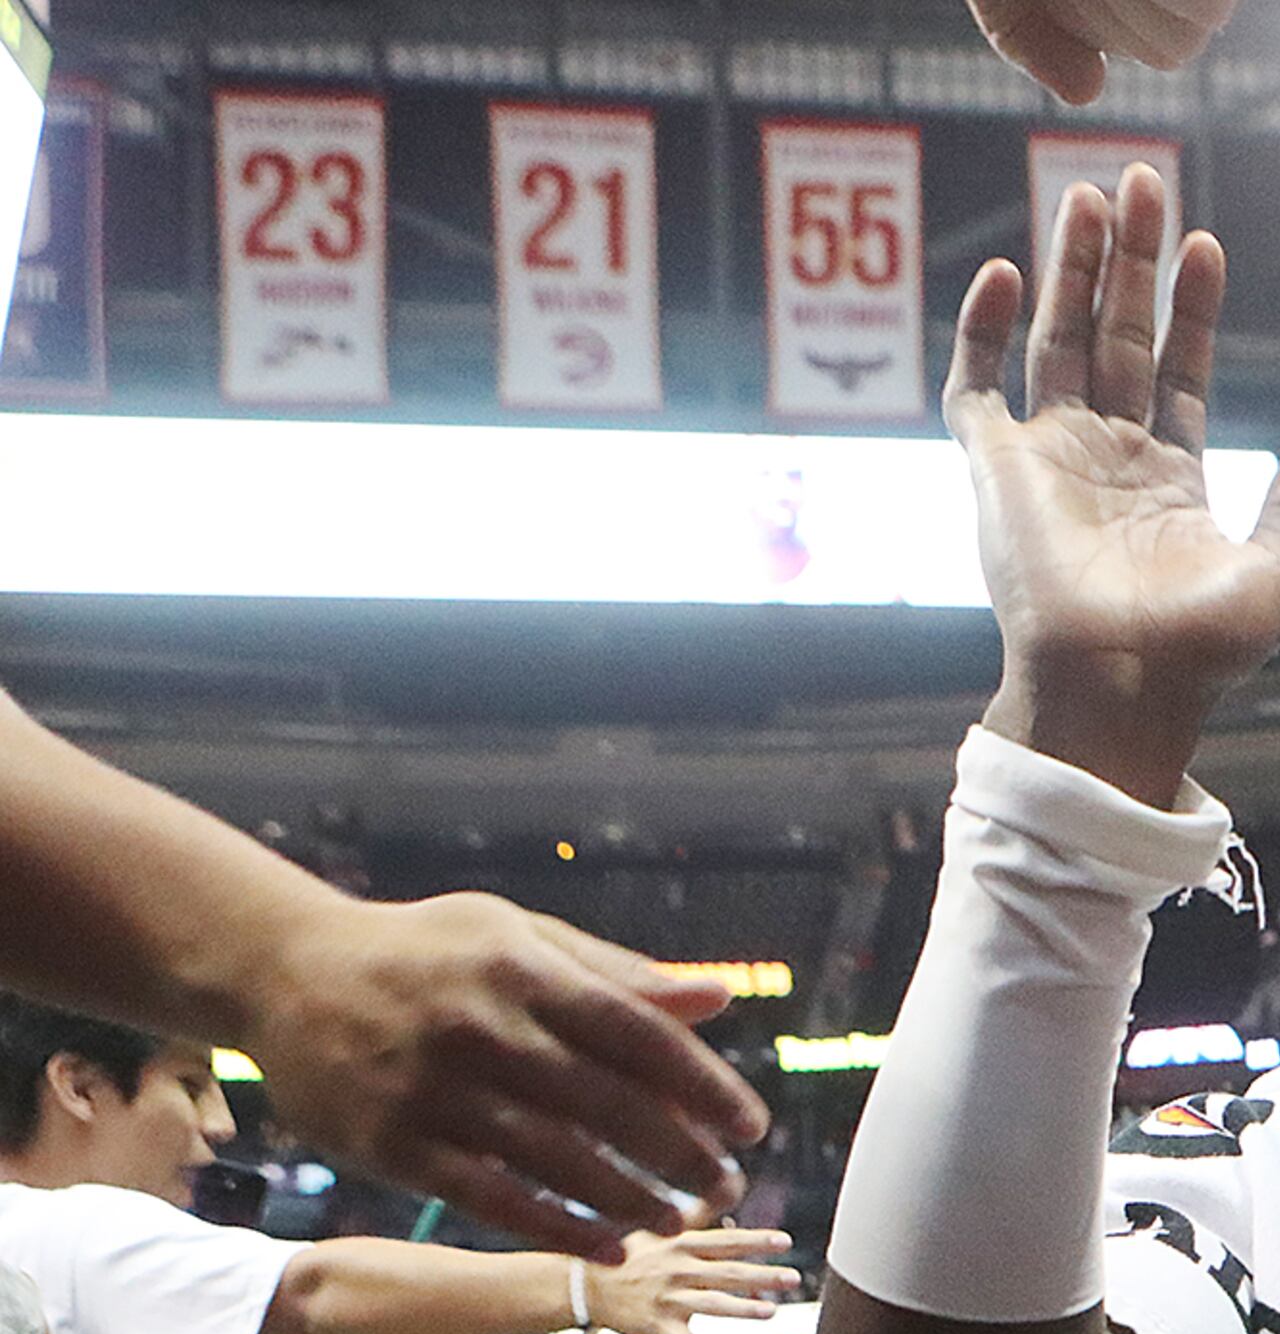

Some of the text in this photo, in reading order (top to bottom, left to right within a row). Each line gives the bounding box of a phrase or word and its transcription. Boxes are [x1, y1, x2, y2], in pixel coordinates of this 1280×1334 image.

[240, 150, 364, 262] 23
[519, 159, 628, 278] 21
[790, 180, 902, 289] 55
